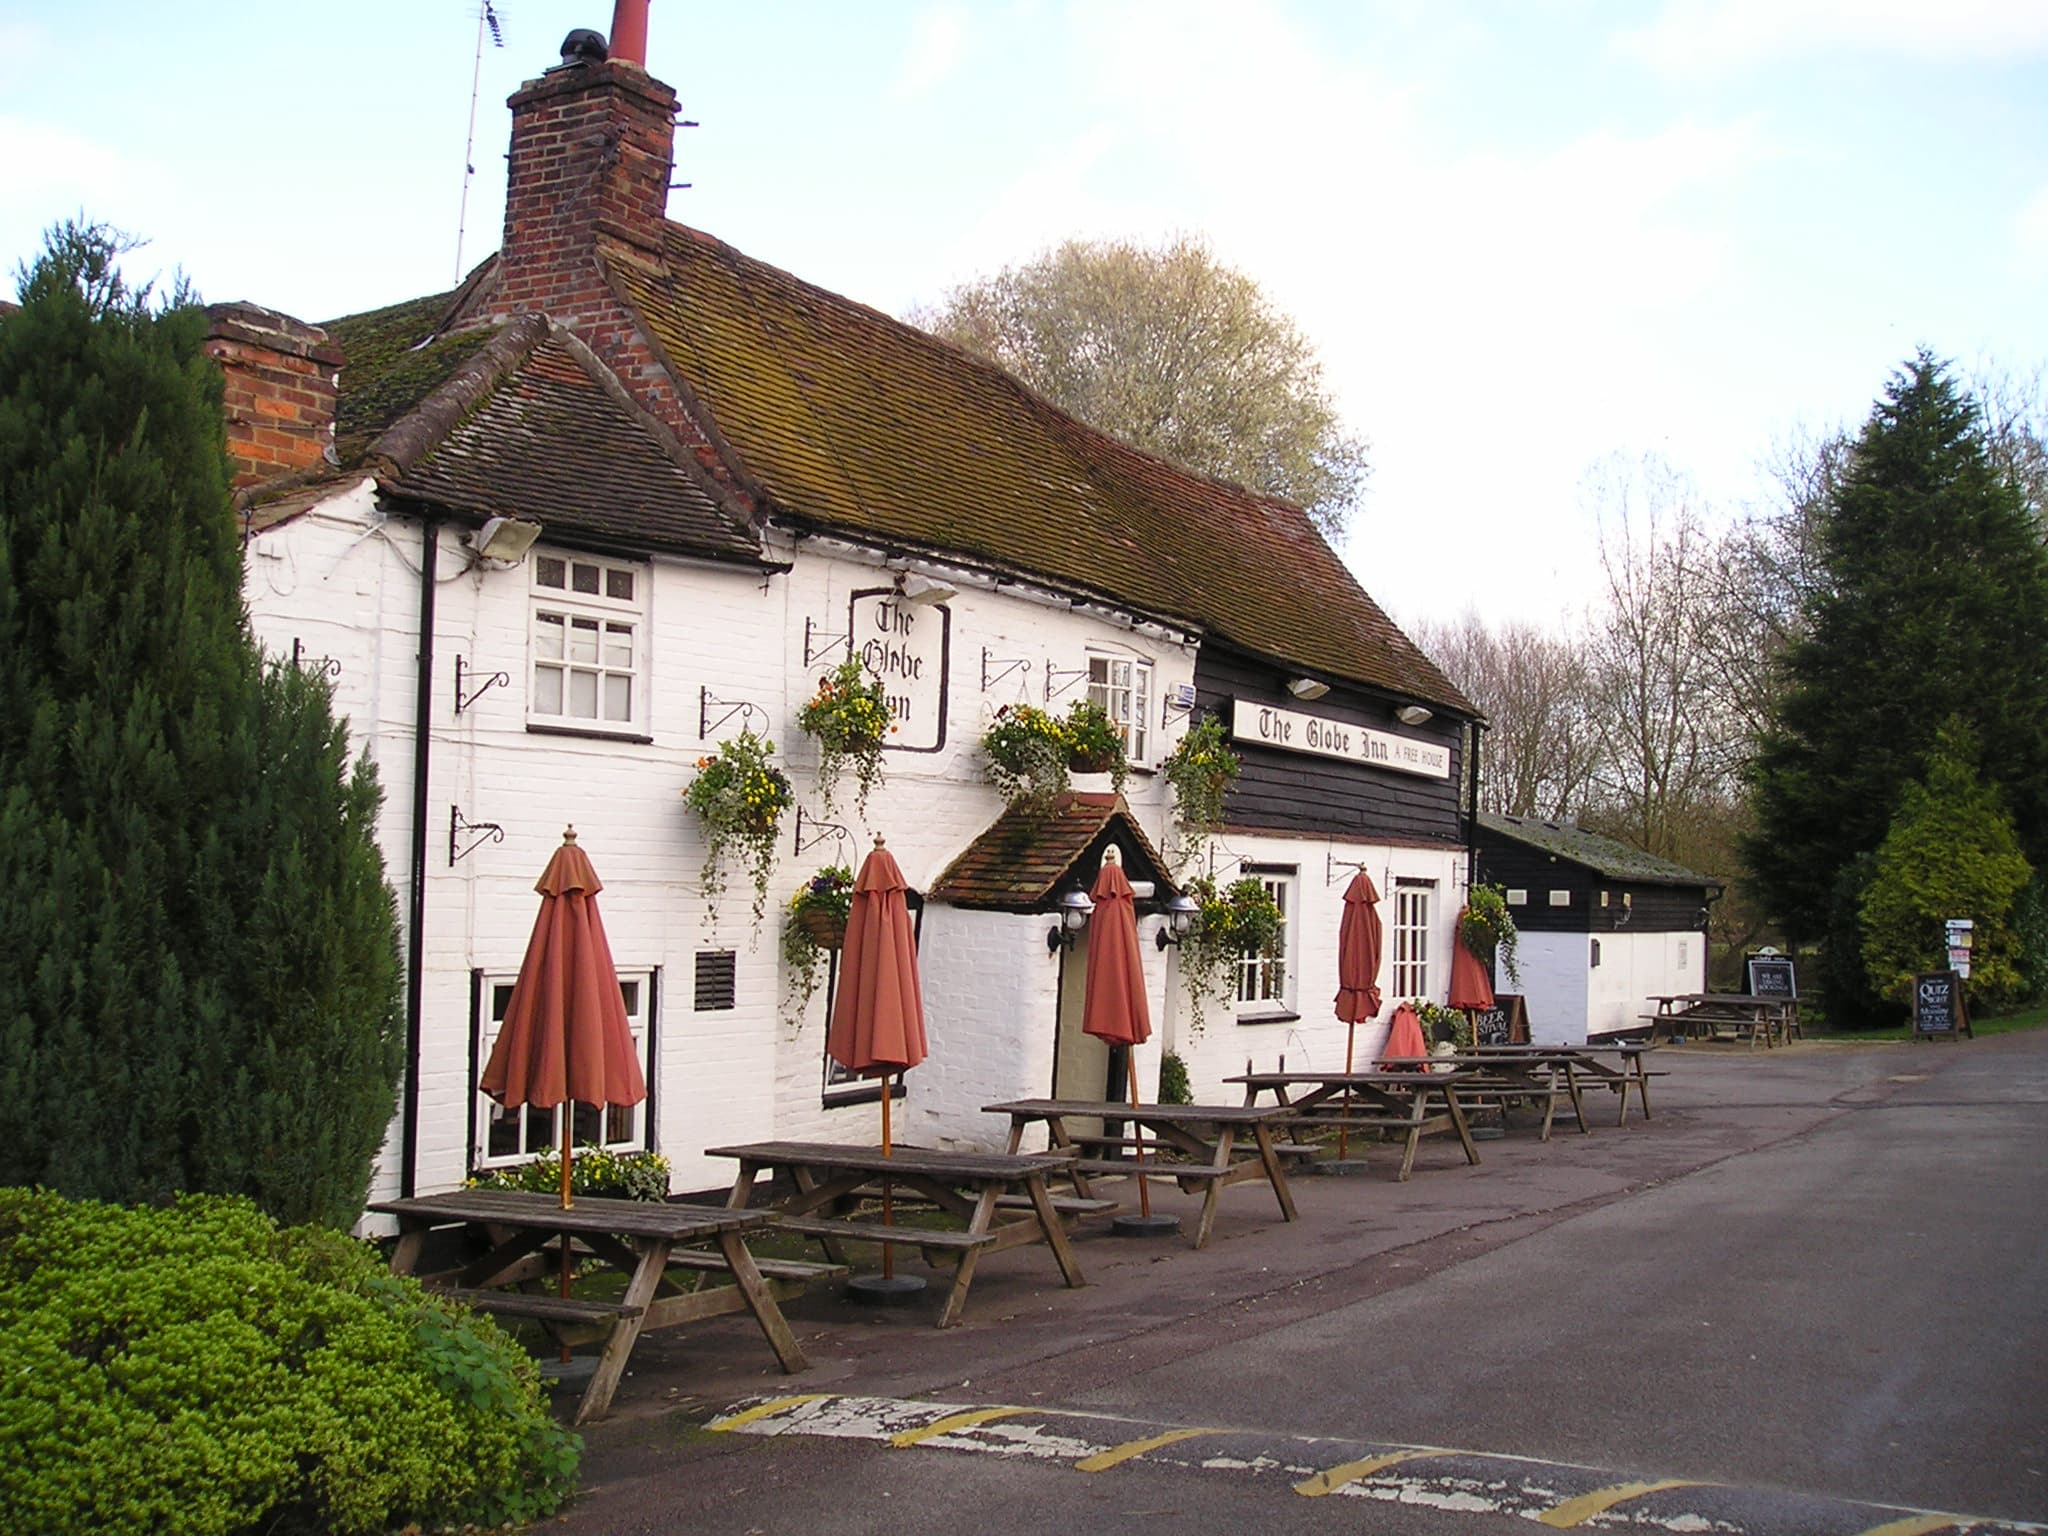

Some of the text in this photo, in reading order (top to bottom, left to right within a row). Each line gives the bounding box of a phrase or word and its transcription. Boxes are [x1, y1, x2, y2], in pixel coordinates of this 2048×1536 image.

[875, 600, 914, 637] The
[1259, 708, 1443, 769] The Globe Inn A FREE HOUSE
[1477, 1010, 1505, 1026] BEER
